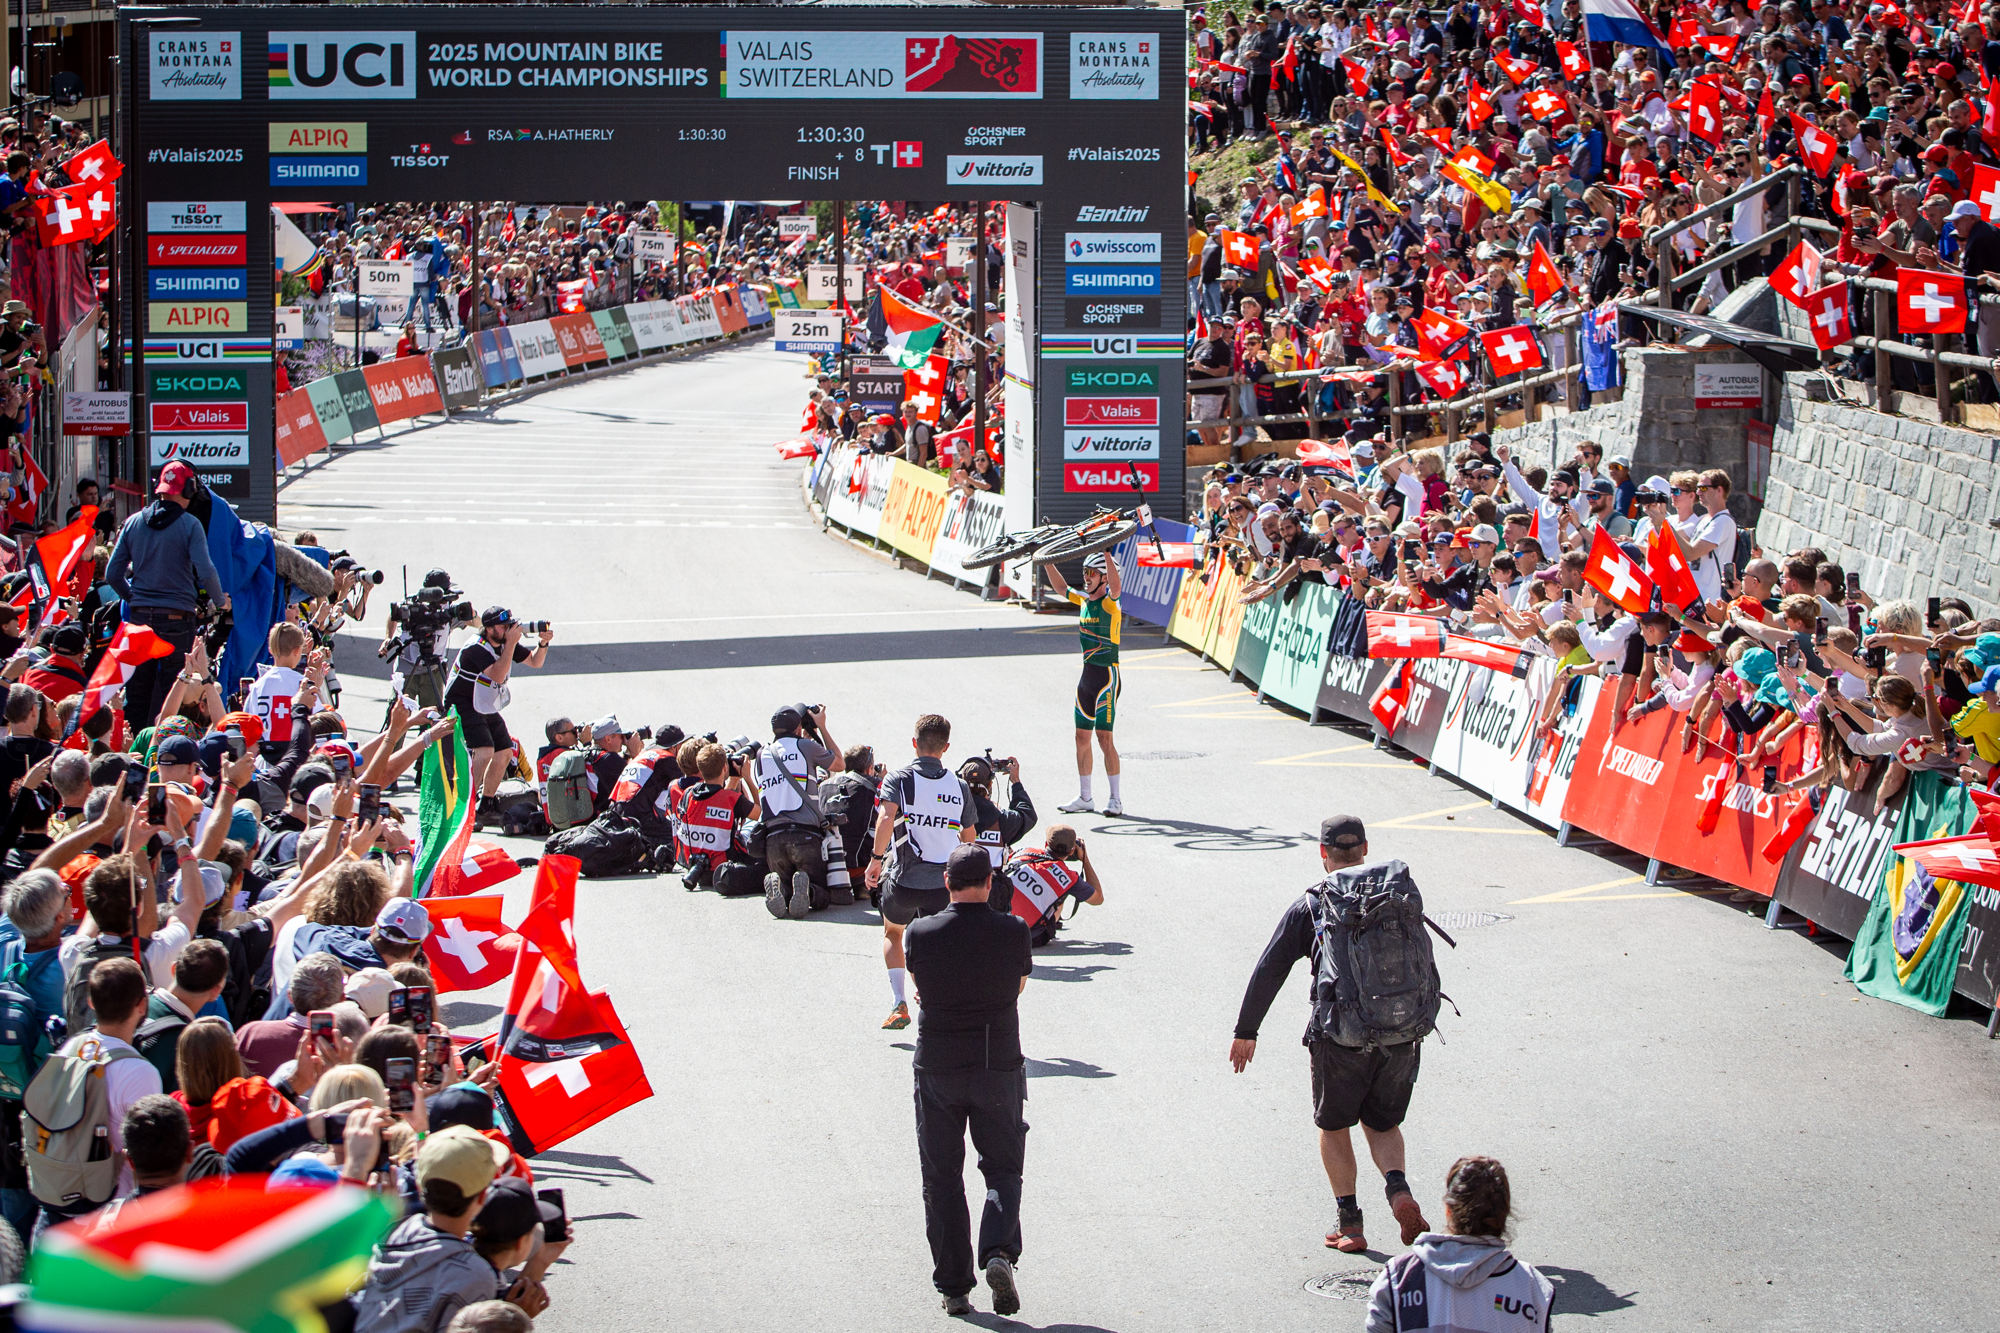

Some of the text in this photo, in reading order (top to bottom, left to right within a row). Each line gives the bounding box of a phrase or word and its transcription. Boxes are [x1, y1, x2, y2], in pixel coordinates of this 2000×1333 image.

[158, 41, 208, 53] CRANS
[428, 42, 662, 61] 2025 MOUNTAIN BIKE
[737, 41, 813, 61] VALAIS
[1078, 41, 1127, 53] CRANS
[158, 55, 232, 67] MONTANA
[293, 42, 404, 87] UCI
[1078, 55, 1150, 68] MONTANA
[161, 69, 227, 90] Absolutely
[428, 67, 708, 87] WORLD CHAMPIONSHIPS
[738, 68, 894, 88] SWITZERLAND
[1080, 71, 1146, 90] Absolutely
[288, 129, 349, 148] ALPIQ
[464, 129, 726, 141] 1 RSA A.HATHERLY 1:30:30
[796, 126, 865, 143] 1:30:30
[967, 126, 1026, 138] OCHSNER
[964, 136, 1005, 146] SPORT
[148, 148, 244, 163] #Valais2025
[390, 155, 450, 167] TISSOT
[855, 147, 865, 162] 8
[1067, 147, 1161, 163] #Valais2025
[277, 164, 360, 177] SHIMANO
[787, 166, 840, 181] FINISH
[975, 162, 1034, 179] vittoria
[171, 214, 223, 225] TISSOT
[1076, 205, 1150, 222] Santini
[167, 244, 238, 256] SPECIALIZED
[641, 239, 665, 250] 75m
[1086, 240, 1156, 254] swisscom
[368, 270, 400, 282] 50m
[1072, 273, 1154, 287] SHIMANO
[155, 277, 240, 291] SHIMANO
[1086, 304, 1144, 314] OCHSNER
[166, 307, 230, 328] ALPIQ
[1082, 313, 1122, 324] SPORT
[791, 322, 829, 336] 25m
[178, 342, 218, 359] UCI
[785, 342, 835, 351] SHIMANO
[1092, 338, 1132, 354] UCI
[402, 373, 435, 399] ValJob
[1719, 376, 1759, 384] AUTOBUS
[370, 381, 403, 406] ValJob
[856, 381, 902, 395] START
[188, 410, 230, 423] Valais
[1101, 405, 1141, 418] Valais
[179, 442, 241, 458] vittoria
[1091, 436, 1152, 452] vittoria
[902, 485, 946, 553] ALPIQ
[941, 794, 962, 806] UCI
[709, 808, 730, 820] UCI
[908, 812, 948, 830] STAFF
[979, 832, 999, 842] UCI
[1051, 866, 1071, 888] UCI
[1401, 1289, 1423, 1308] 110
